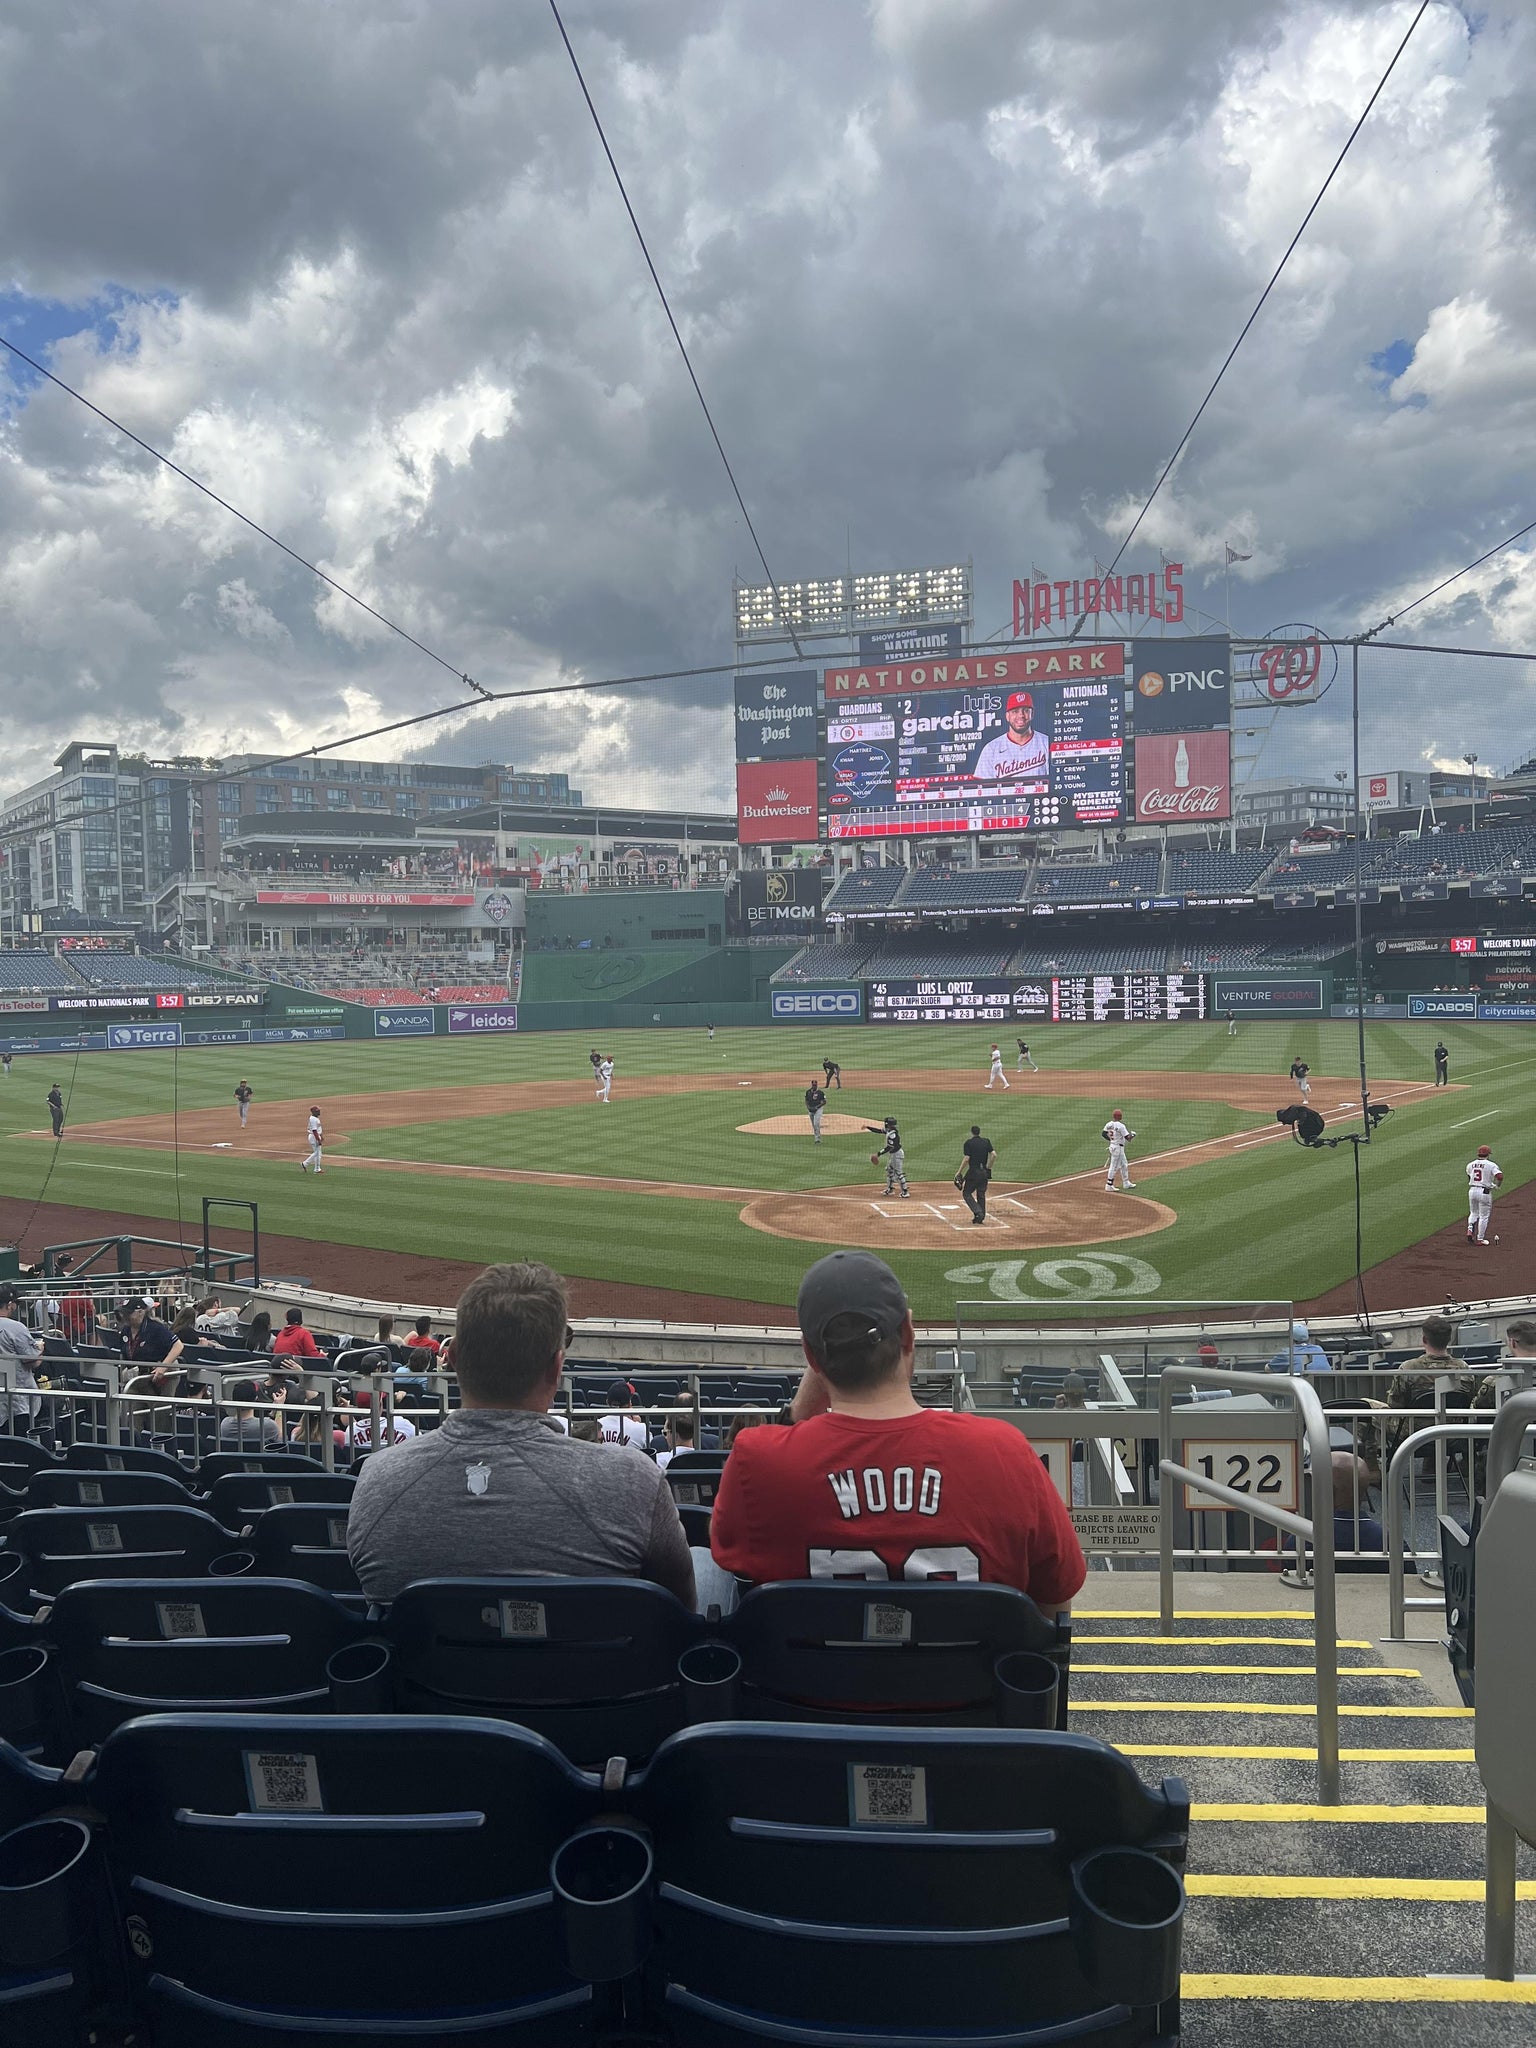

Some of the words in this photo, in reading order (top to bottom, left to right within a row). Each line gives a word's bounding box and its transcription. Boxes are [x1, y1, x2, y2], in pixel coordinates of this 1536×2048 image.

[1013, 564, 1183, 637] NATIONALS
[872, 633, 894, 642] SHOW
[896, 630, 918, 640] SOME
[835, 661, 1008, 690] NATIONALS
[1026, 652, 1106, 675] PARK
[1168, 670, 1225, 692] PNC
[763, 684, 787, 702] The
[1063, 684, 1108, 698] NATIONALS
[964, 694, 1002, 712] luis
[738, 704, 814, 722] Washington
[839, 702, 882, 716] GUARDIANS
[902, 710, 973, 736] garcía
[976, 709, 1002, 731] jr.
[761, 725, 790, 744] Post
[995, 752, 1046, 778] Nationals
[1074, 790, 1120, 799] MYSTERY
[1140, 784, 1225, 814] Coca-Cola
[1072, 797, 1122, 806] MOMENTS
[743, 804, 812, 818] Budweiser
[328, 893, 347, 903] THIS
[350, 893, 374, 903] BUD'S
[376, 894, 392, 903] FOR
[393, 894, 412, 903] YOU.
[748, 906, 815, 920] BETMGM
[1388, 940, 1426, 949] WASHINGTON
[1406, 943, 1438, 952] NATIONALS
[1455, 940, 1471, 950] 3:57
[1483, 940, 1511, 948] WELCOME
[1460, 950, 1487, 958] NATIONALS
[1495, 965, 1531, 973] network
[873, 984, 887, 994] #45
[917, 983, 936, 994] LUIS
[938, 983, 946, 994] L.
[948, 982, 973, 994] ORTIZ
[1500, 982, 1516, 990] rely
[226, 995, 259, 1004] FAN
[892, 997, 904, 1005] 86.7
[920, 996, 941, 1004] SLIDER
[1013, 995, 1048, 1004] PMSI
[1222, 991, 1271, 1000] VENTURE
[1273, 991, 1315, 1000] GLOBAL
[15, 1000, 46, 1010] Teeter
[58, 999, 87, 1008] WELCOME
[88, 999, 97, 1008] TO
[98, 998, 132, 1008] NATIONALS
[133, 997, 149, 1006] PARK
[161, 996, 178, 1006] 3:57
[775, 994, 857, 1012] GEICO
[1427, 1003, 1473, 1012] DABOS
[1485, 1007, 1536, 1016] citycruises
[242, 1020, 250, 1028] 377
[390, 1016, 430, 1024] VANDA
[471, 1012, 514, 1028] leidos
[133, 1028, 176, 1044] Terra
[1474, 1170, 1482, 1182] 3
[1197, 1454, 1282, 1493] 122
[827, 1466, 942, 1519] WOOD
[1070, 1515, 1099, 1523] LEASE
[1102, 1515, 1114, 1523] BE
[1117, 1515, 1148, 1523] AWARE
[1152, 1515, 1160, 1523] O
[1074, 1526, 1114, 1535] OBJECTS
[1117, 1526, 1155, 1534] LEAVING
[1091, 1536, 1109, 1544] THE
[1113, 1536, 1140, 1544] FIELD
